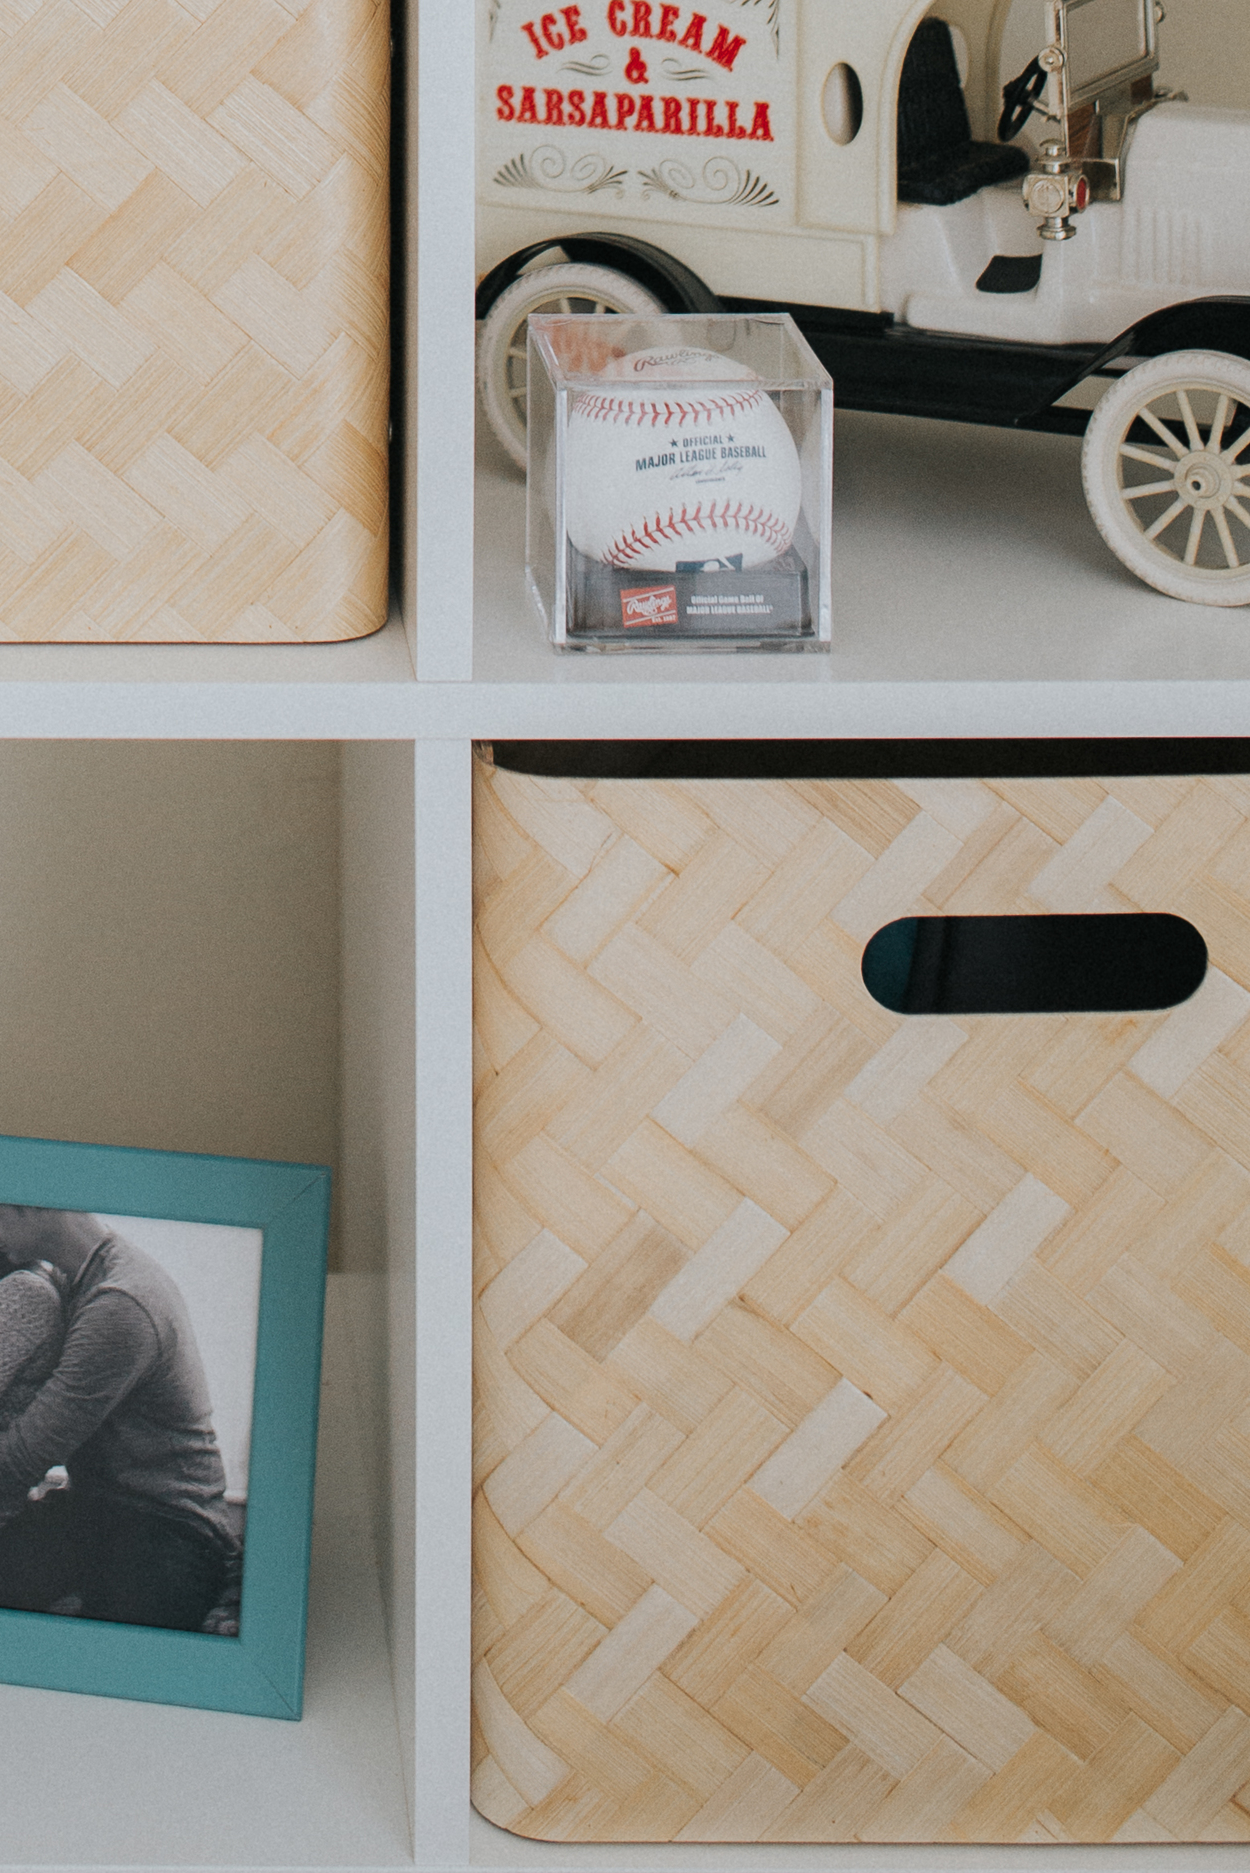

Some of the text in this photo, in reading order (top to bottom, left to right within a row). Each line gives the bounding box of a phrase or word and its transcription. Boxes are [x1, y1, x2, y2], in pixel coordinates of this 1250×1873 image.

[520, 4, 588, 60] ICE
[624, 47, 649, 84] &
[496, 84, 775, 142] SARSAPARILLA
[682, 434, 724, 448] OFFICIAL
[635, 452, 676, 471] MAJOR
[679, 448, 717, 464] LEAGUE
[720, 445, 767, 459] BASEBALL
[626, 595, 672, 616] Rawlings
[686, 605, 710, 614] MAJOR
[710, 605, 736, 614] LEAGUE
